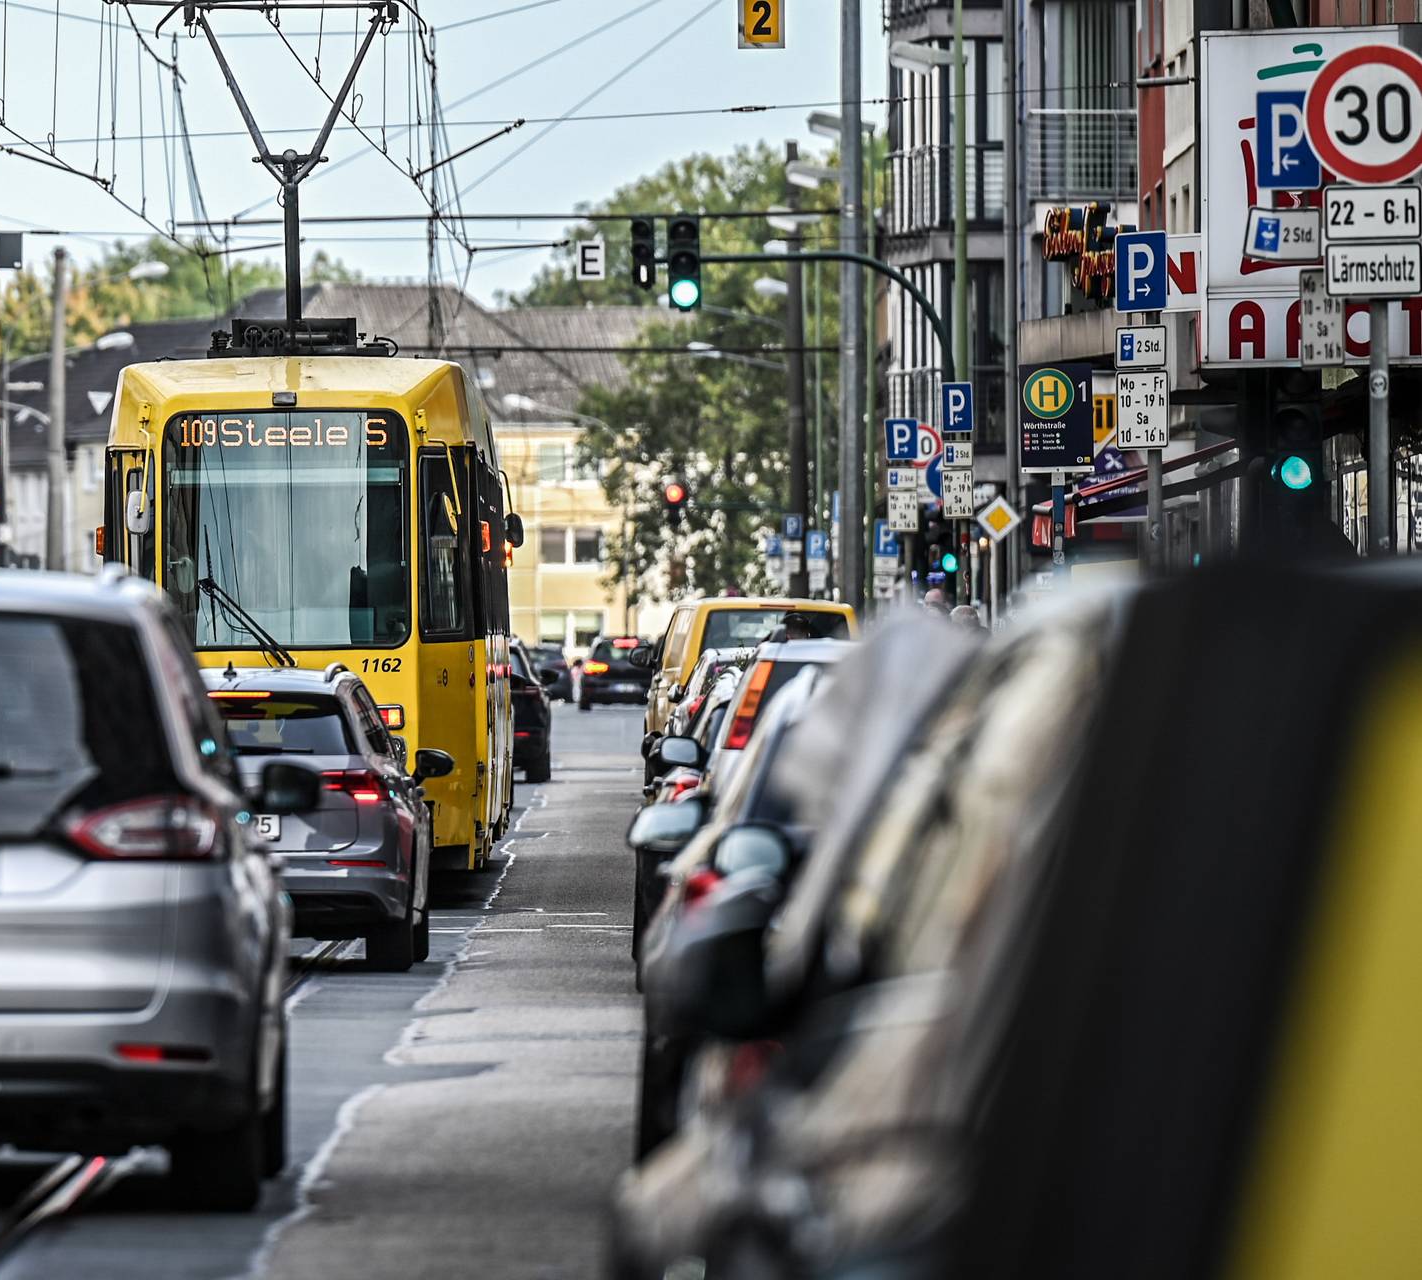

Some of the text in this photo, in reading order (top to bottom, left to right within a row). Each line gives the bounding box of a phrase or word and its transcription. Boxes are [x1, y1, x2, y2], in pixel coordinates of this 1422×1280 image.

[753, 1, 771, 35] 2
[1335, 84, 1411, 146] 30
[1272, 103, 1304, 176] P
[1331, 201, 1355, 226] 22
[1384, 199, 1395, 224] 6
[1405, 198, 1416, 223] h
[1283, 227, 1315, 243] 2 Std.
[581, 245, 600, 275] E
[1332, 254, 1415, 283] Lärmschutz
[1128, 244, 1155, 301] P
[1304, 299, 1314, 315] 10
[1317, 320, 1328, 337] Sa
[1136, 340, 1162, 352] 2 Std.
[1120, 378, 1135, 391] Mo
[1154, 376, 1164, 390] Fr
[1038, 380, 1087, 408] H 1
[1120, 395, 1131, 408] 10
[1145, 395, 1155, 407] 19
[1159, 394, 1165, 406] h
[949, 389, 965, 426] P
[1023, 421, 1066, 430] Wörthstraße
[1137, 413, 1149, 425] Sa
[180, 418, 387, 447] 109 Steele S
[893, 424, 911, 455] P
[1121, 430, 1131, 443] 10
[1145, 430, 1155, 442] 16
[1159, 428, 1165, 441] h
[944, 473, 953, 481] Mo
[964, 473, 970, 481] Fr
[944, 485, 951, 493] 10
[958, 484, 965, 493] 19
[954, 495, 962, 504] Sa
[880, 525, 893, 552] P
[361, 658, 402, 672] 1162
